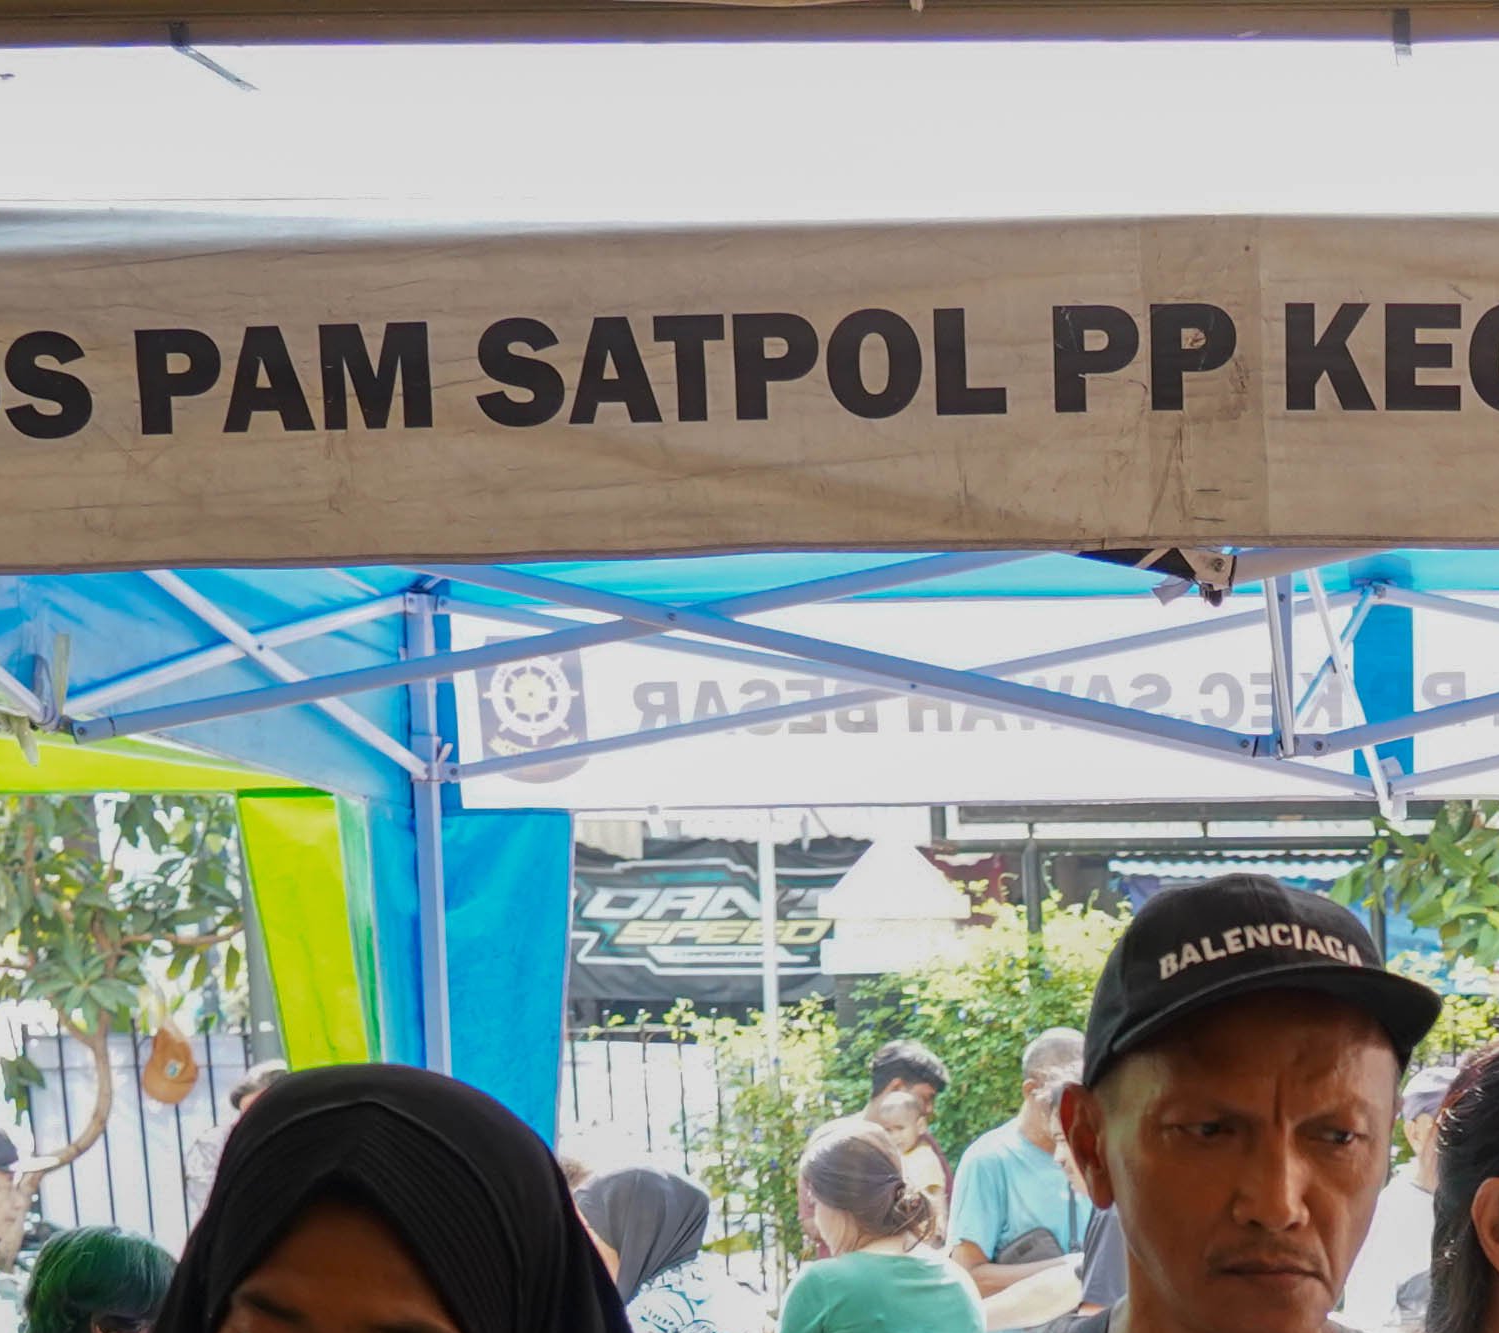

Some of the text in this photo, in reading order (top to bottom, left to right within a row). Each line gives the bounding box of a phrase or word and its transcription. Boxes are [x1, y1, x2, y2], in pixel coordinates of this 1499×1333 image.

[133, 320, 434, 436] PAM
[476, 307, 1008, 429] SATPOL
[1052, 303, 1238, 414] PP
[1157, 922, 1364, 981] BALENCIAGA
